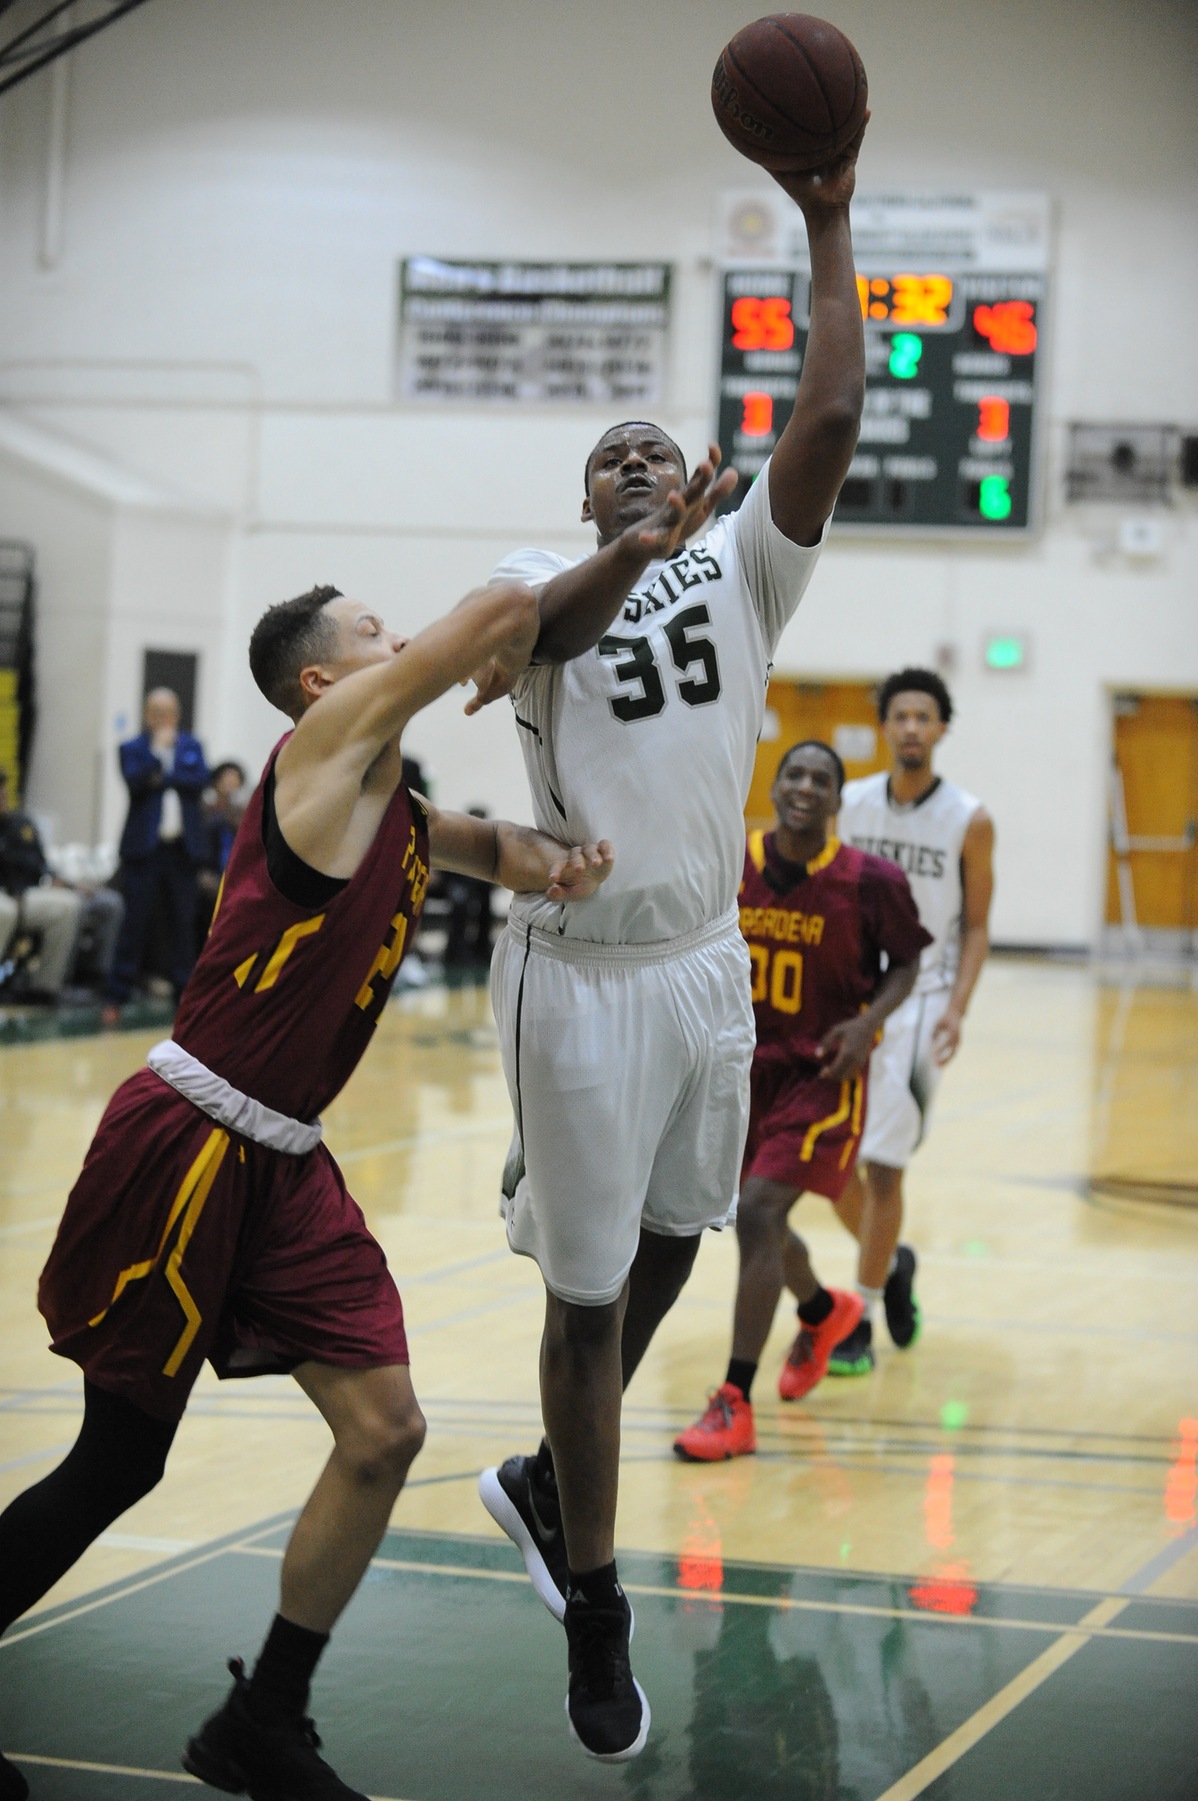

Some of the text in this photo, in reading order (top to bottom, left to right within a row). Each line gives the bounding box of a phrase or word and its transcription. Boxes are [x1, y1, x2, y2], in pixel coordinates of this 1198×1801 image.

[731, 297, 795, 351] 55
[889, 332, 923, 379] 2
[979, 474, 1012, 521] 6
[624, 548, 722, 623] SKIES
[598, 600, 724, 726] 35
[739, 906, 825, 946] ASADENA
